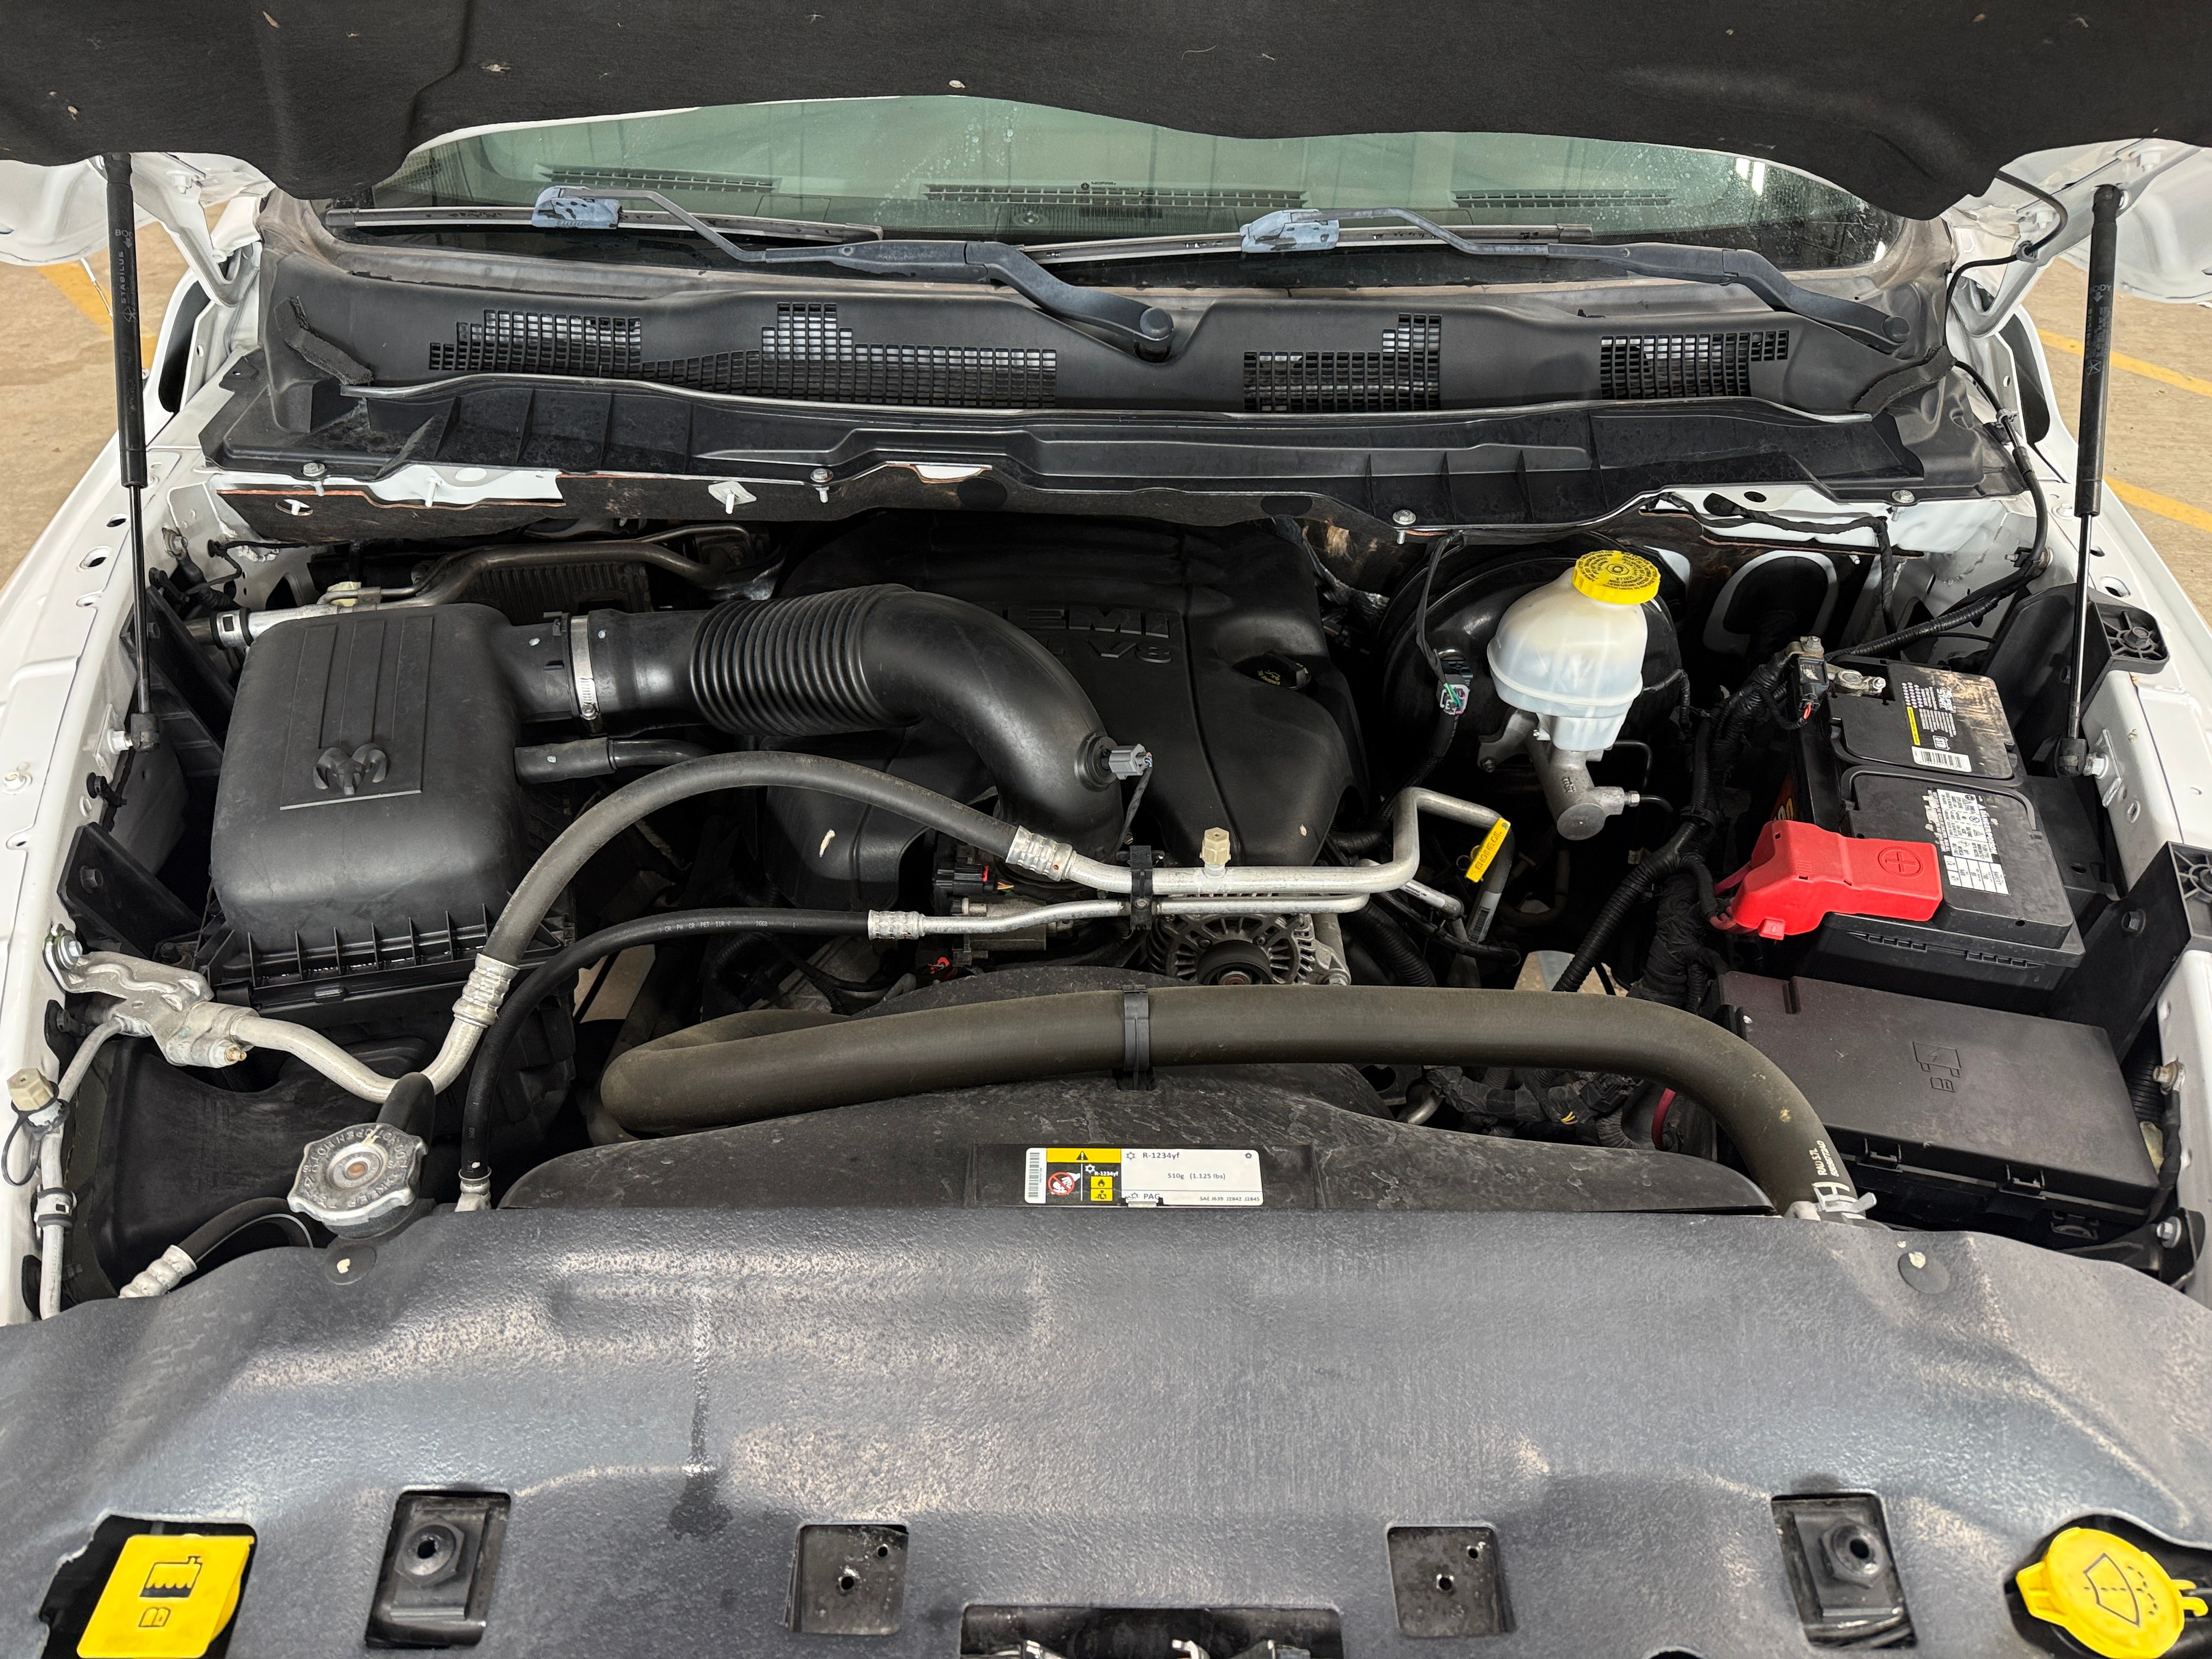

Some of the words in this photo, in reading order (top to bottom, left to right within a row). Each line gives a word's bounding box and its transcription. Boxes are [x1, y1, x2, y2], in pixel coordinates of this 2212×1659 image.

[118, 251, 127, 304] STABILUS
[1000, 605, 1170, 639] EMI
[1085, 637, 1173, 664] V8
[1474, 840, 1495, 871] ENGINE
[1490, 830, 1502, 843] OIL
[1815, 1161, 1828, 1176] RAD
